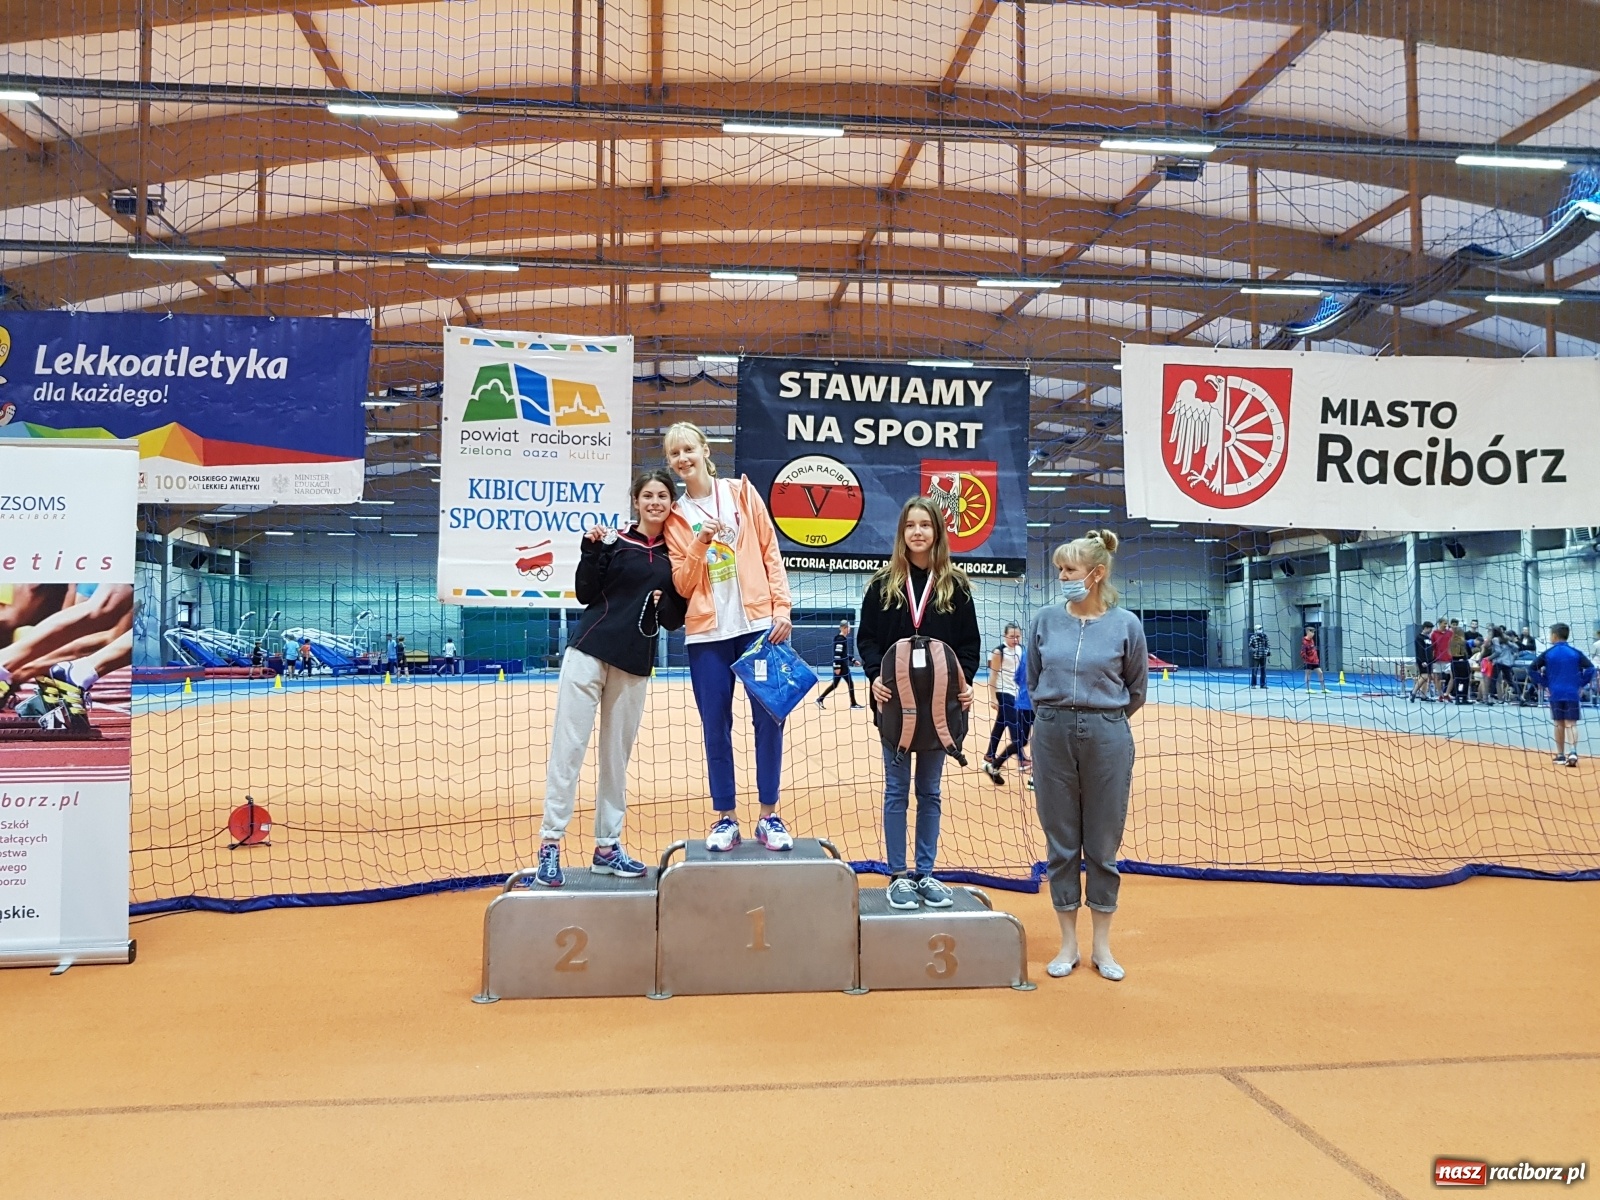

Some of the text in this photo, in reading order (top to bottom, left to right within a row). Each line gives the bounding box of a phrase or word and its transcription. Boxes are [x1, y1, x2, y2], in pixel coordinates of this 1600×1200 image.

[33, 344, 288, 385] Lekkoatletyka
[33, 382, 169, 407] dla każdego!
[779, 371, 993, 407] STAWIAMY
[1320, 397, 1458, 429] MIASTO
[460, 427, 612, 447] powiat raciborski
[787, 414, 983, 449] NA SPORT
[460, 445, 611, 460] zielona oaza kultur
[1316, 433, 1567, 486] Racibórz
[155, 475, 187, 490] 100
[468, 478, 605, 507] KIBICUJEMY
[777, 465, 856, 499] VICTORIA RACIBÓRZ
[0, 496, 66, 511] ZSOMS
[801, 485, 832, 518] V
[449, 507, 620, 533] SPORTOWCOM
[805, 534, 828, 544] 1970
[2, 550, 113, 571] etics
[1, 791, 79, 811] borz.pl
[0, 820, 29, 829] Szkół
[745, 905, 771, 952] 1
[554, 926, 588, 973] 2
[926, 933, 958, 980] 3
